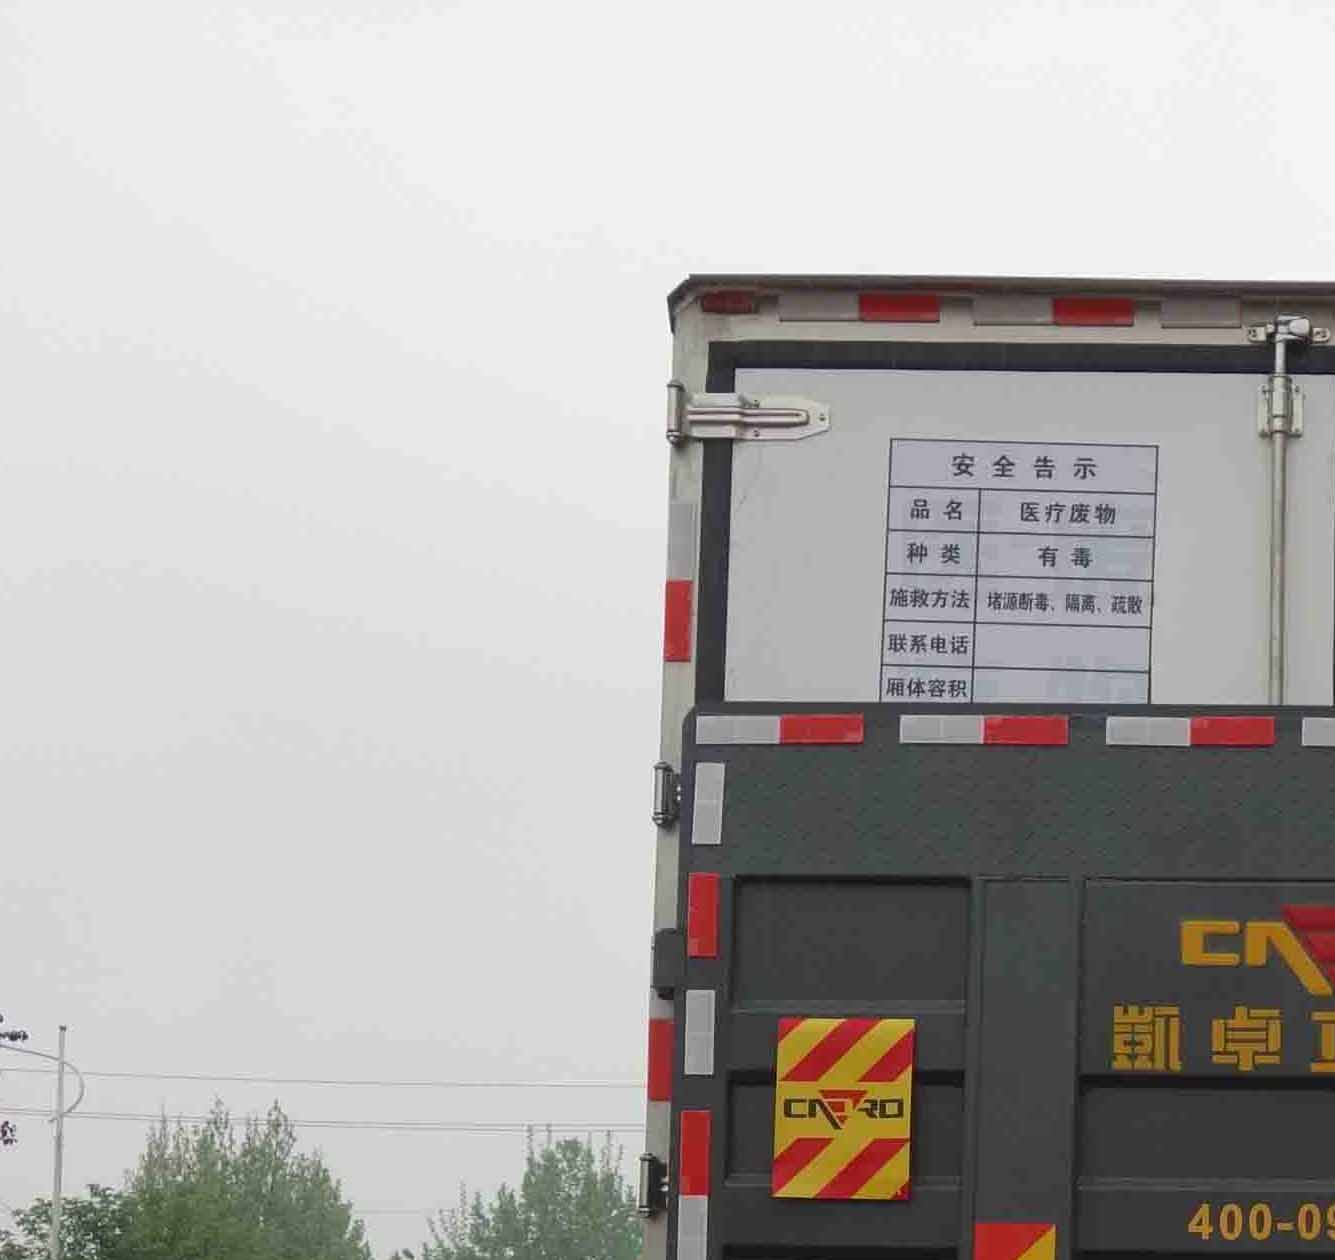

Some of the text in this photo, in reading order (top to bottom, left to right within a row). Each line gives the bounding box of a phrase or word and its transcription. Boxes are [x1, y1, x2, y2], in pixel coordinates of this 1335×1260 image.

[952, 453, 1097, 480] 安全告示
[910, 499, 963, 521] 品名
[1020, 502, 1116, 525] 医疗废物
[906, 542, 961, 565] 种类
[1037, 546, 1094, 568] 有毒
[889, 588, 970, 610] 施救方法
[887, 633, 969, 655] 联系电话
[886, 678, 967, 698] 厢体容积
